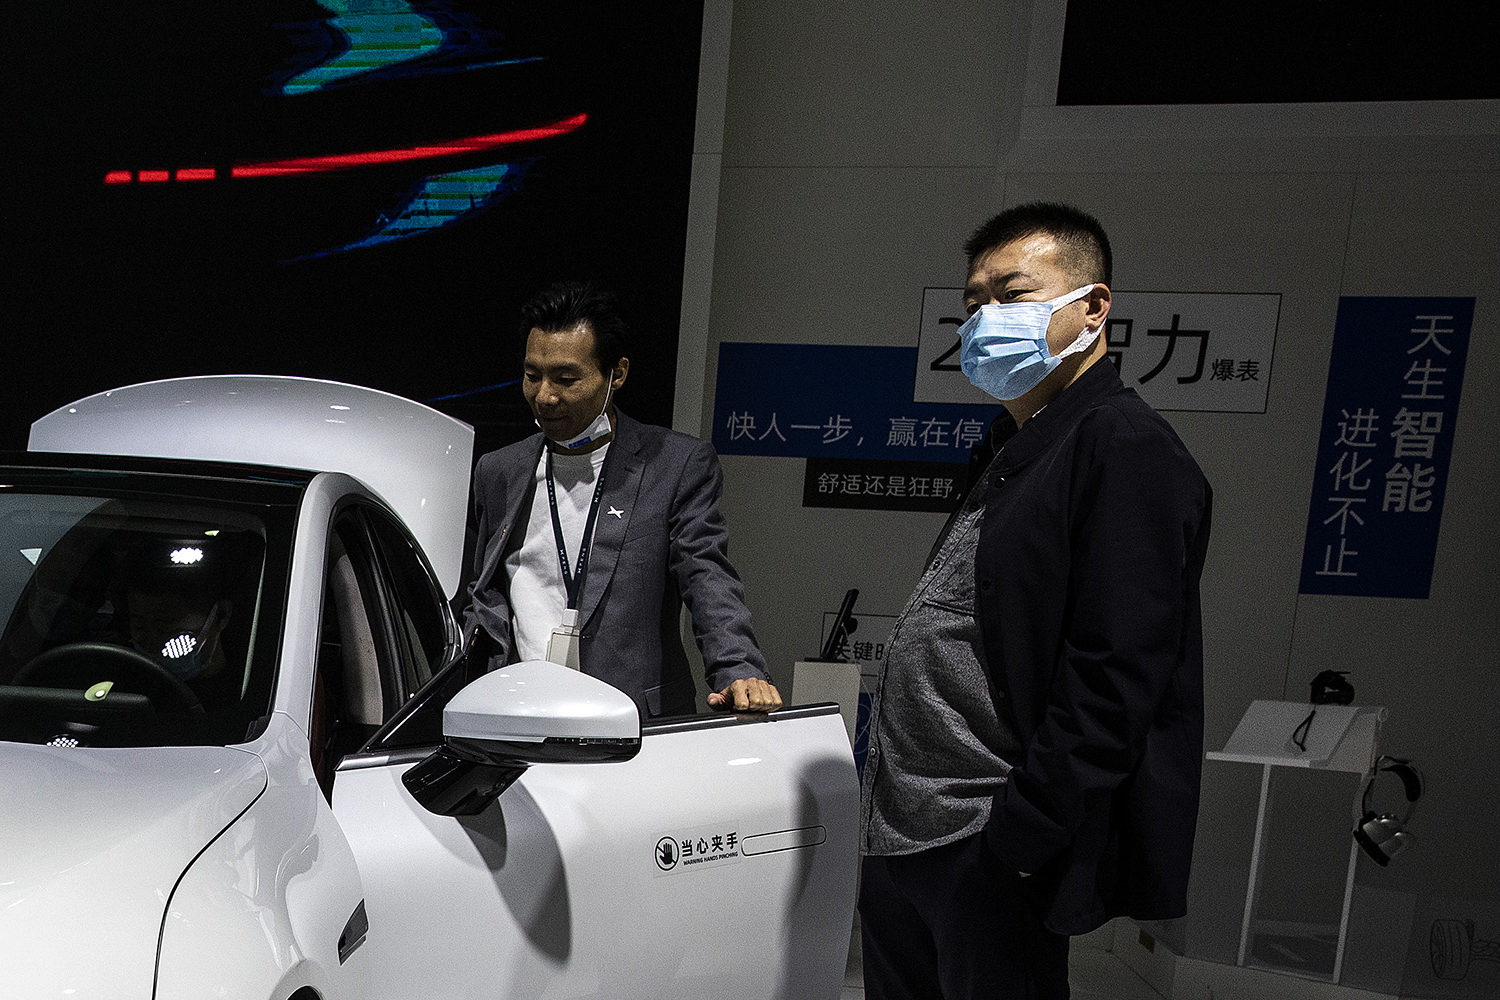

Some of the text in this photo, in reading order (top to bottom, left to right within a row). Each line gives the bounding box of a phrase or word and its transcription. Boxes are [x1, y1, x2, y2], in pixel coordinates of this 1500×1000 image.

[1316, 407, 1380, 577] 进化不止
[1382, 315, 1454, 513] 天生智能
[681, 832, 738, 857] 当心夹手
